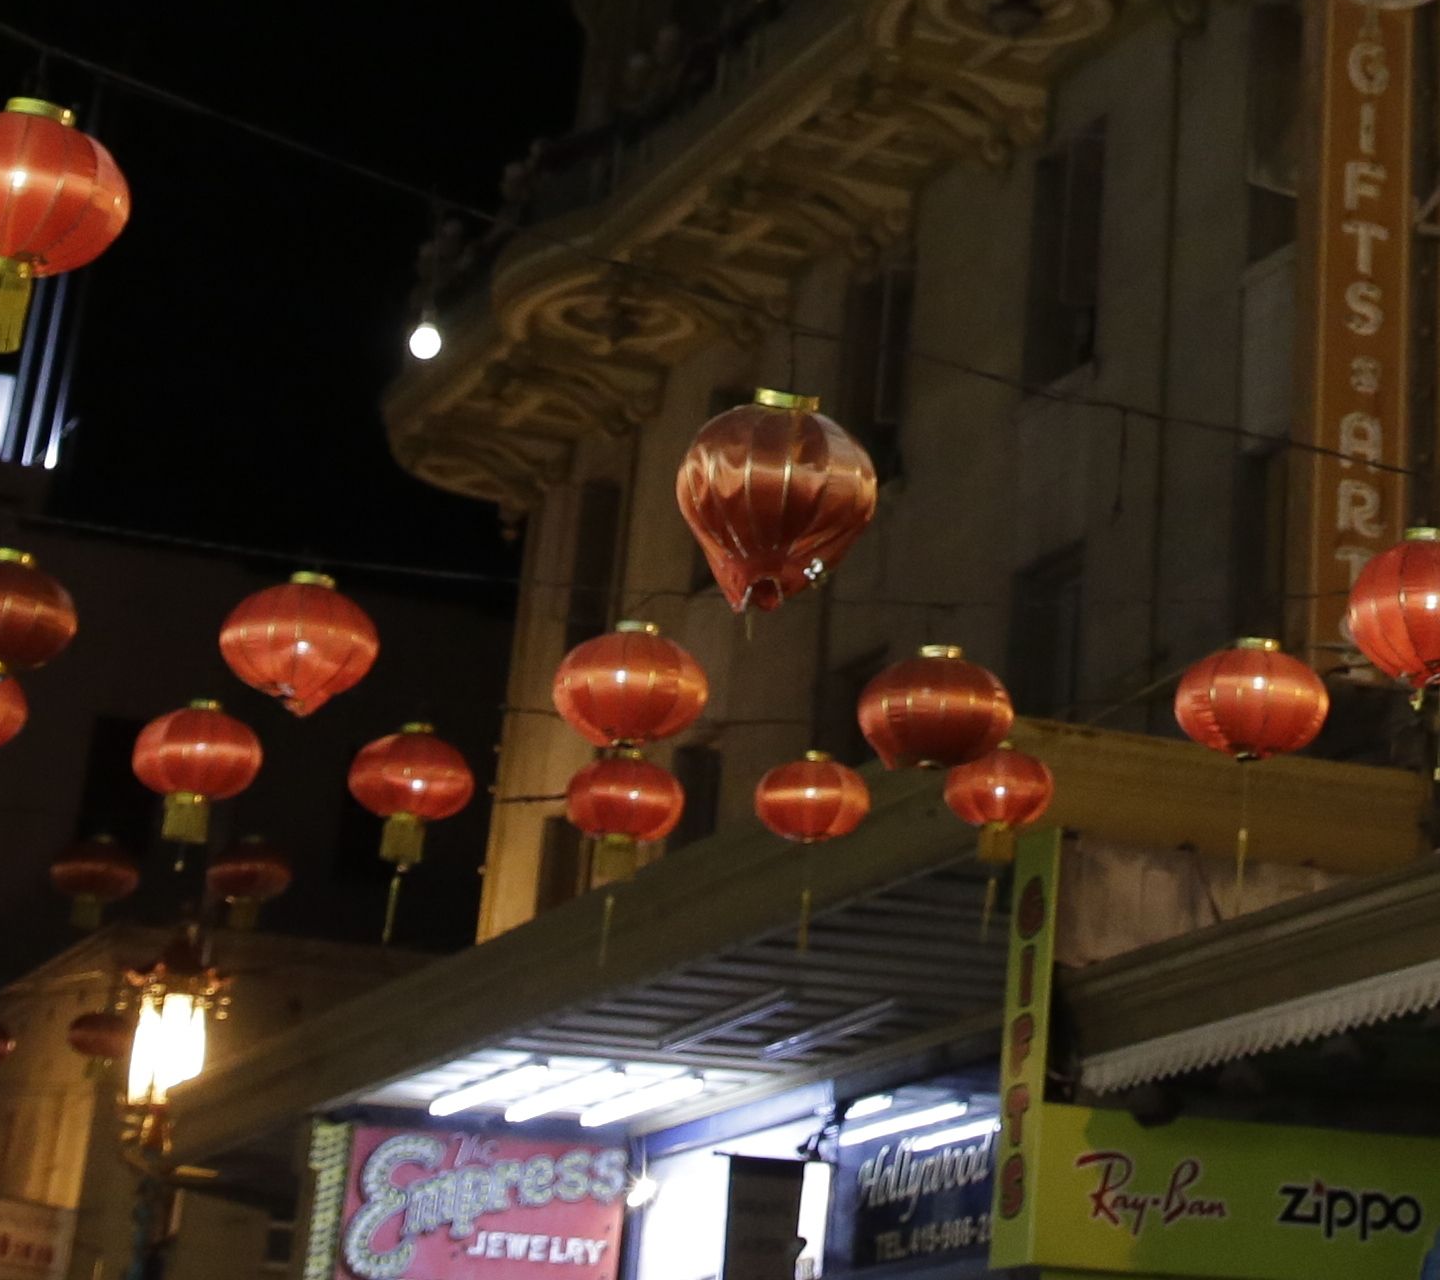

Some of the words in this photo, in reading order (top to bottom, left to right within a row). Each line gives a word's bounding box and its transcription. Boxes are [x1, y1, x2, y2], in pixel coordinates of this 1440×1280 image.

[1342, 41, 1390, 337] GIFTS
[997, 873, 1046, 1221] GIFTS
[454, 1130, 499, 1167] The
[857, 1130, 996, 1224] Hollywood
[343, 1133, 629, 1280] Empress
[466, 1230, 609, 1266] JEWELRY
[1279, 1179, 1422, 1240] zippo
